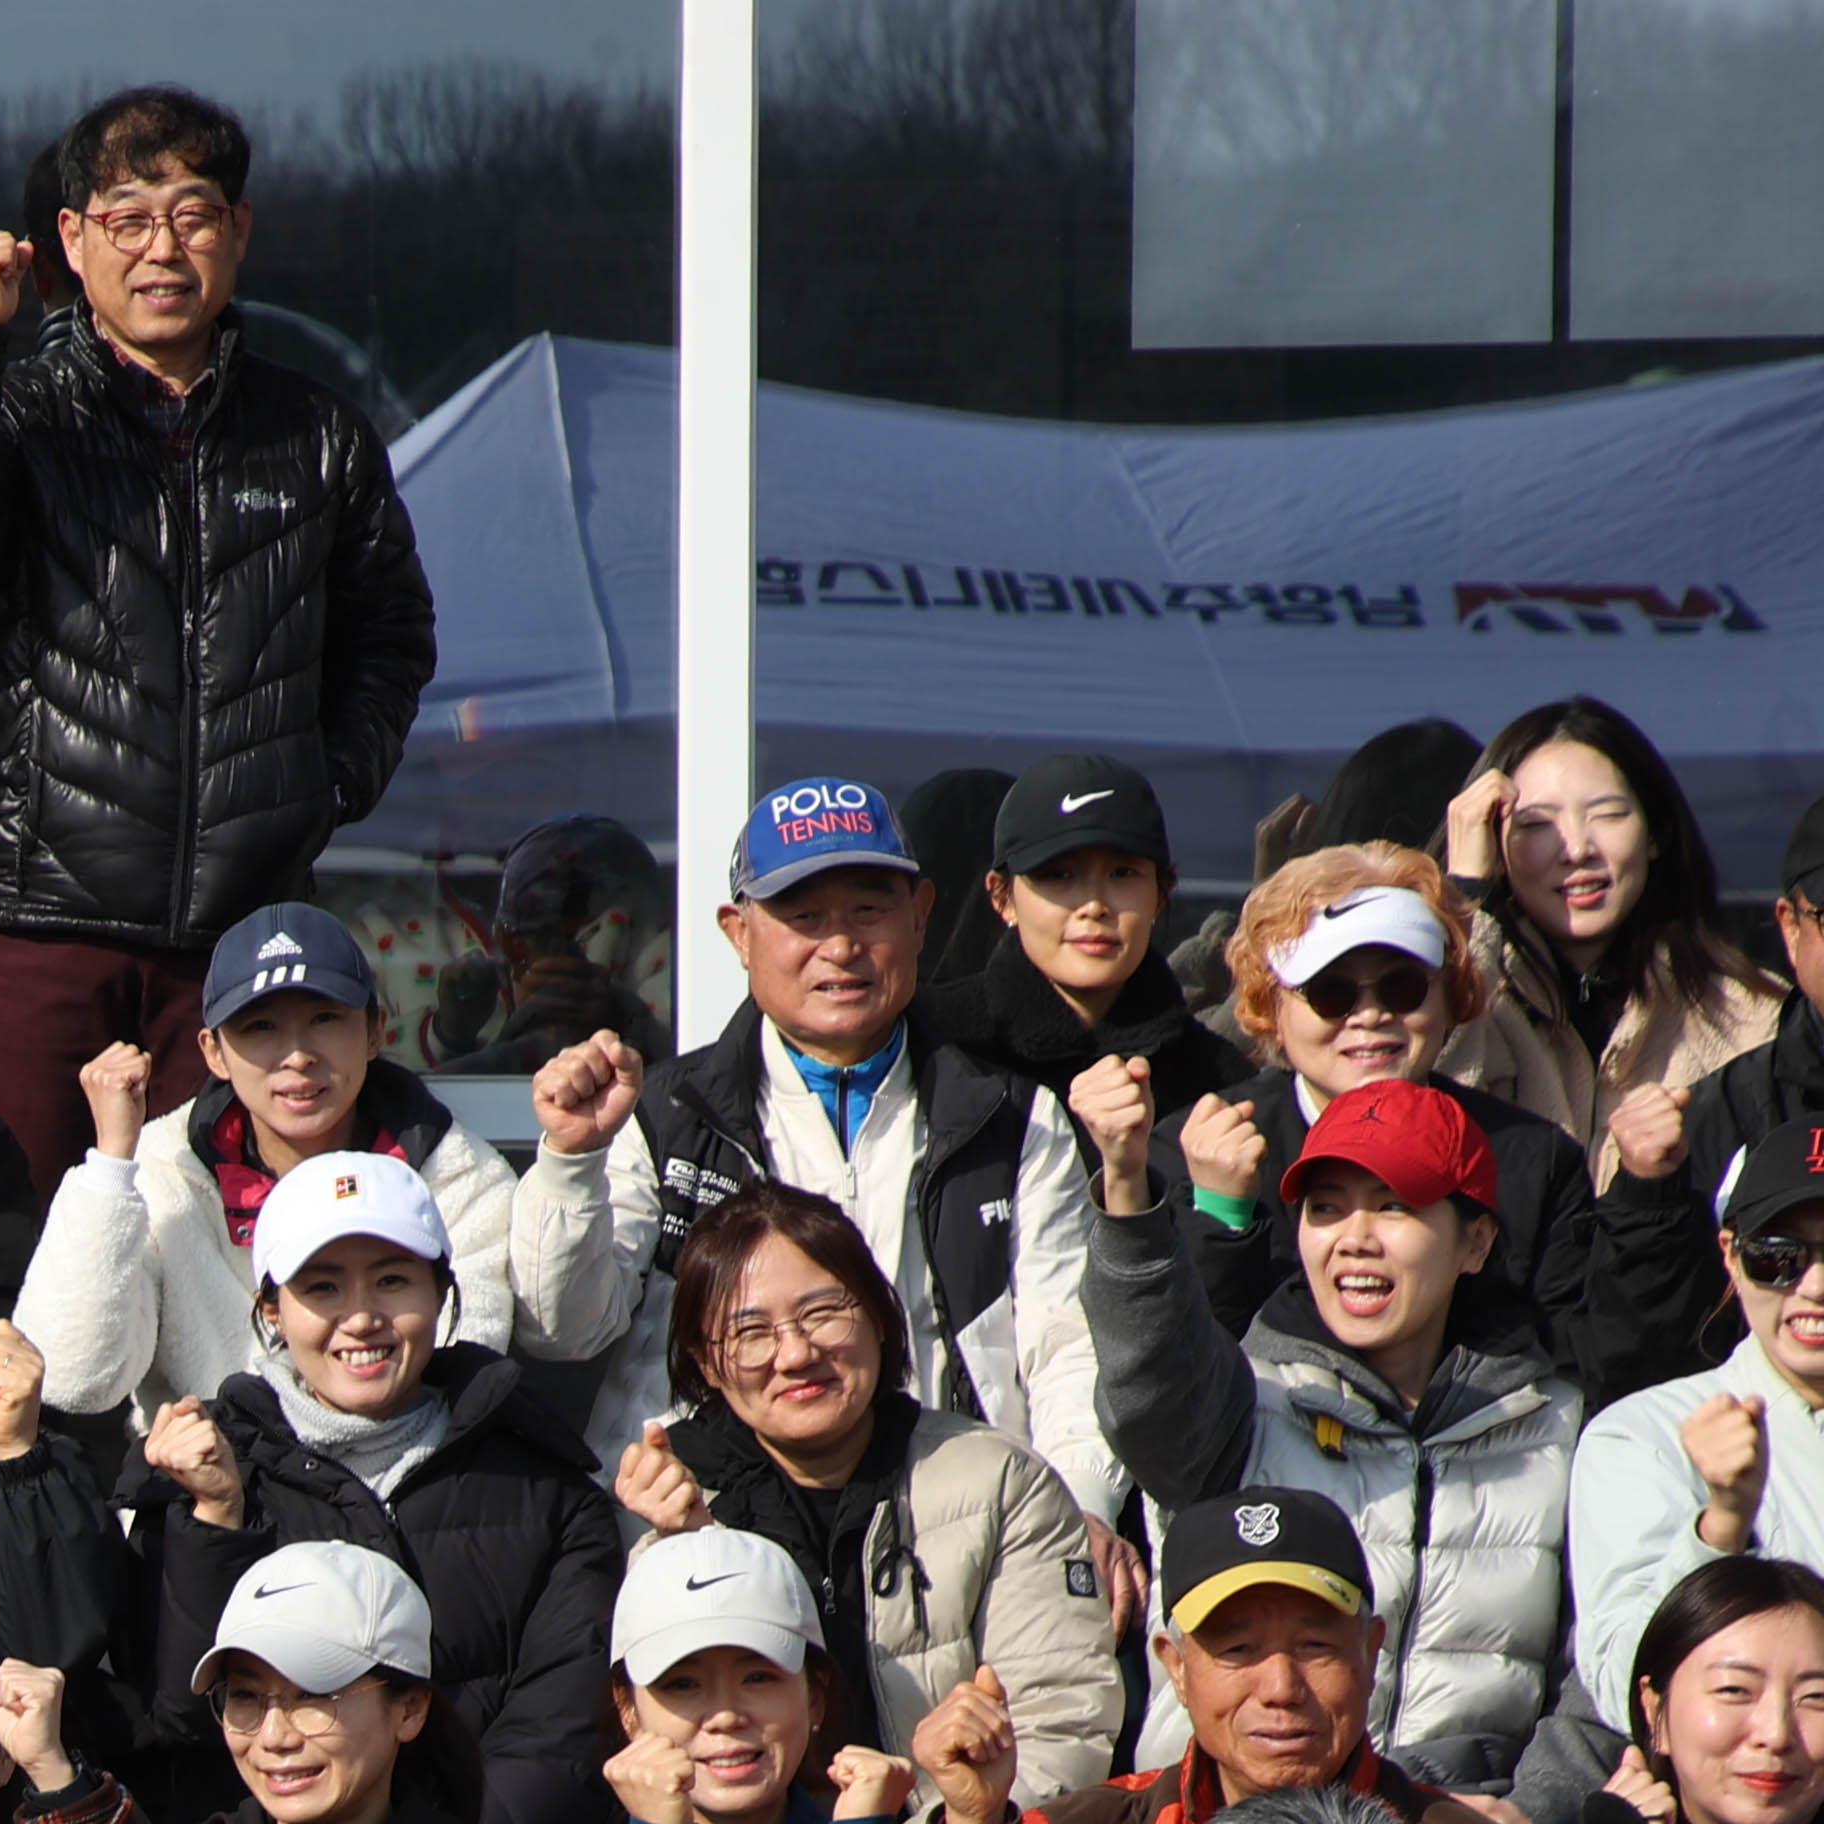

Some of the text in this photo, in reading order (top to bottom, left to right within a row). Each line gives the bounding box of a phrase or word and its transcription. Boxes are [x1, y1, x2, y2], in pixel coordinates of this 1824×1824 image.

[770, 783, 867, 825] POLO
[777, 811, 874, 845] TENNIS
[257, 943, 303, 960] adidas
[978, 1198, 1013, 1227] FIL
